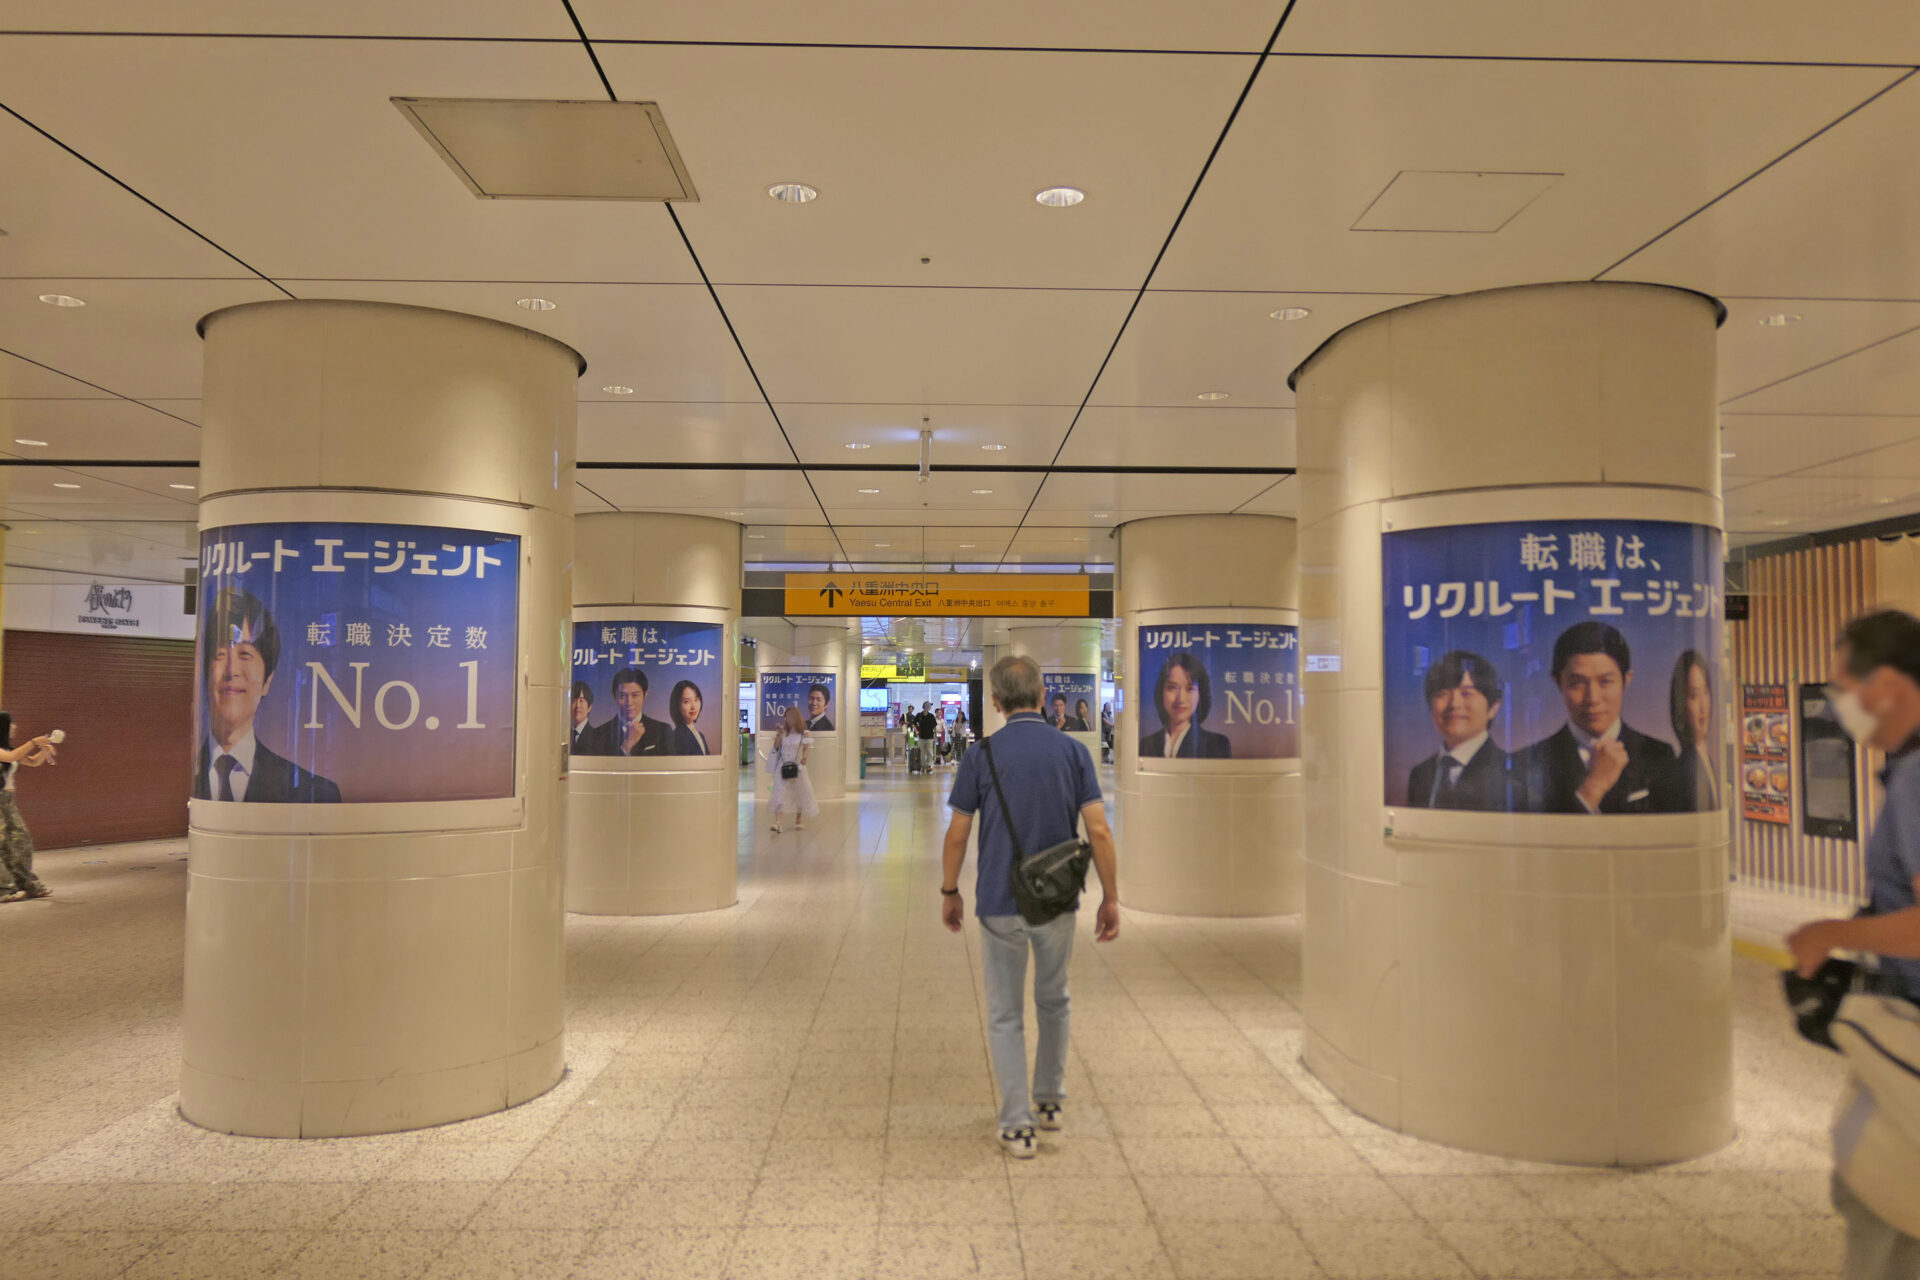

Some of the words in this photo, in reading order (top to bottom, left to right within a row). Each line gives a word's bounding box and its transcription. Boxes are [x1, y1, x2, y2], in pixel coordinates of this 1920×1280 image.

[202, 539, 300, 578] リクルート
[311, 538, 502, 579] エージェント
[1519, 532, 1662, 572] 転職は、
[849, 580, 939, 596] 八重洲中央口
[1403, 579, 1576, 620] リクルート
[1588, 578, 1720, 619] エージェント
[849, 598, 877, 607] Yaesu
[879, 598, 912, 607] Central
[914, 598, 932, 607] Exit
[306, 621, 489, 650] 転職決定数
[601, 626, 668, 645] 転職は、
[1146, 630, 1220, 649] リクルート
[1225, 630, 1298, 650] エージェント
[573, 647, 624, 666] クルート
[628, 647, 716, 666] エージェント
[763, 675, 793, 684] リクルート
[795, 675, 833, 684] エージェント
[303, 660, 486, 731] No.1
[1224, 689, 1296, 725] No.1
